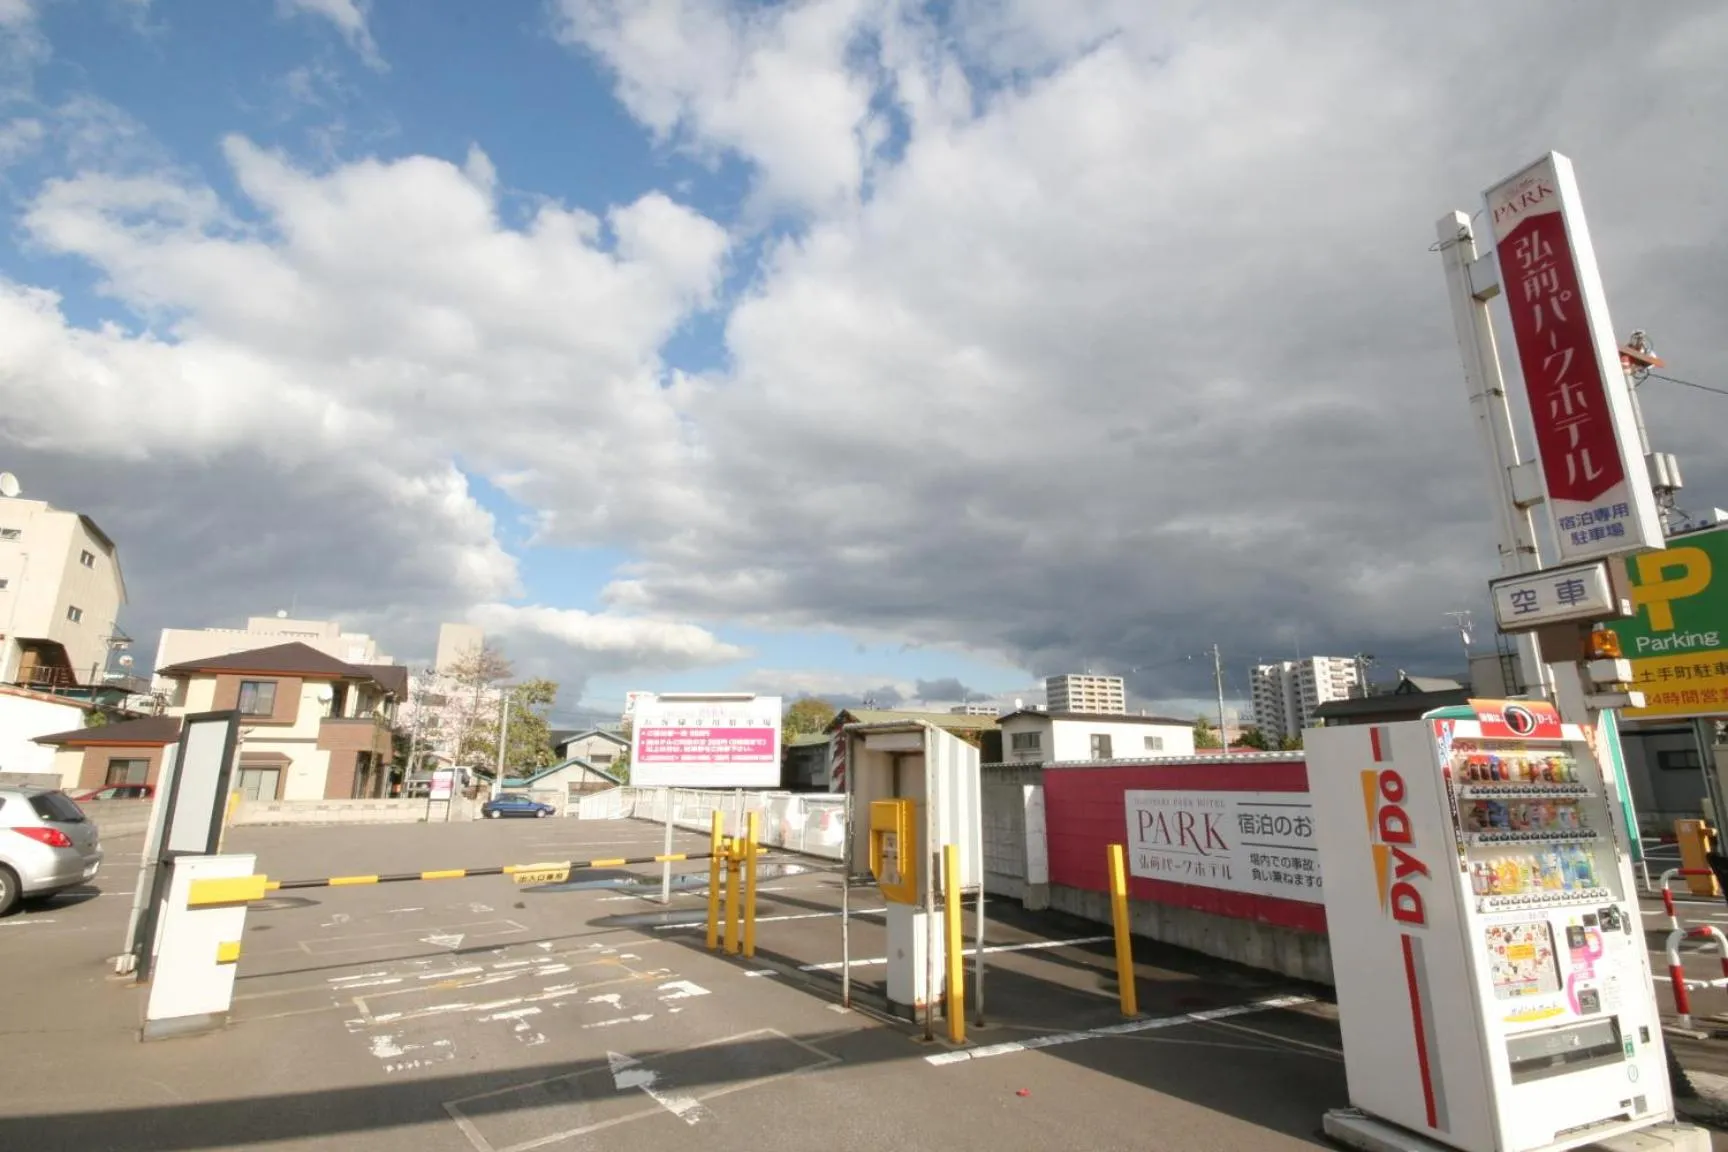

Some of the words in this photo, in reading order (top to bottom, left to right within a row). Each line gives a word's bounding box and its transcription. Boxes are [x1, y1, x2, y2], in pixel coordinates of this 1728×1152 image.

[1494, 184, 1553, 223] PARK
[1513, 230, 1604, 486] 弘前パークホテル
[1559, 502, 1630, 531] 宿泊専用
[1571, 522, 1625, 546] 駐車場
[1510, 579, 1589, 615] 空車
[1636, 630, 1720, 653] Parking
[1136, 809, 1231, 856] PARK
[1237, 813, 1313, 838] 宿泊のお
[1139, 853, 1233, 881] 弘前パークホテル
